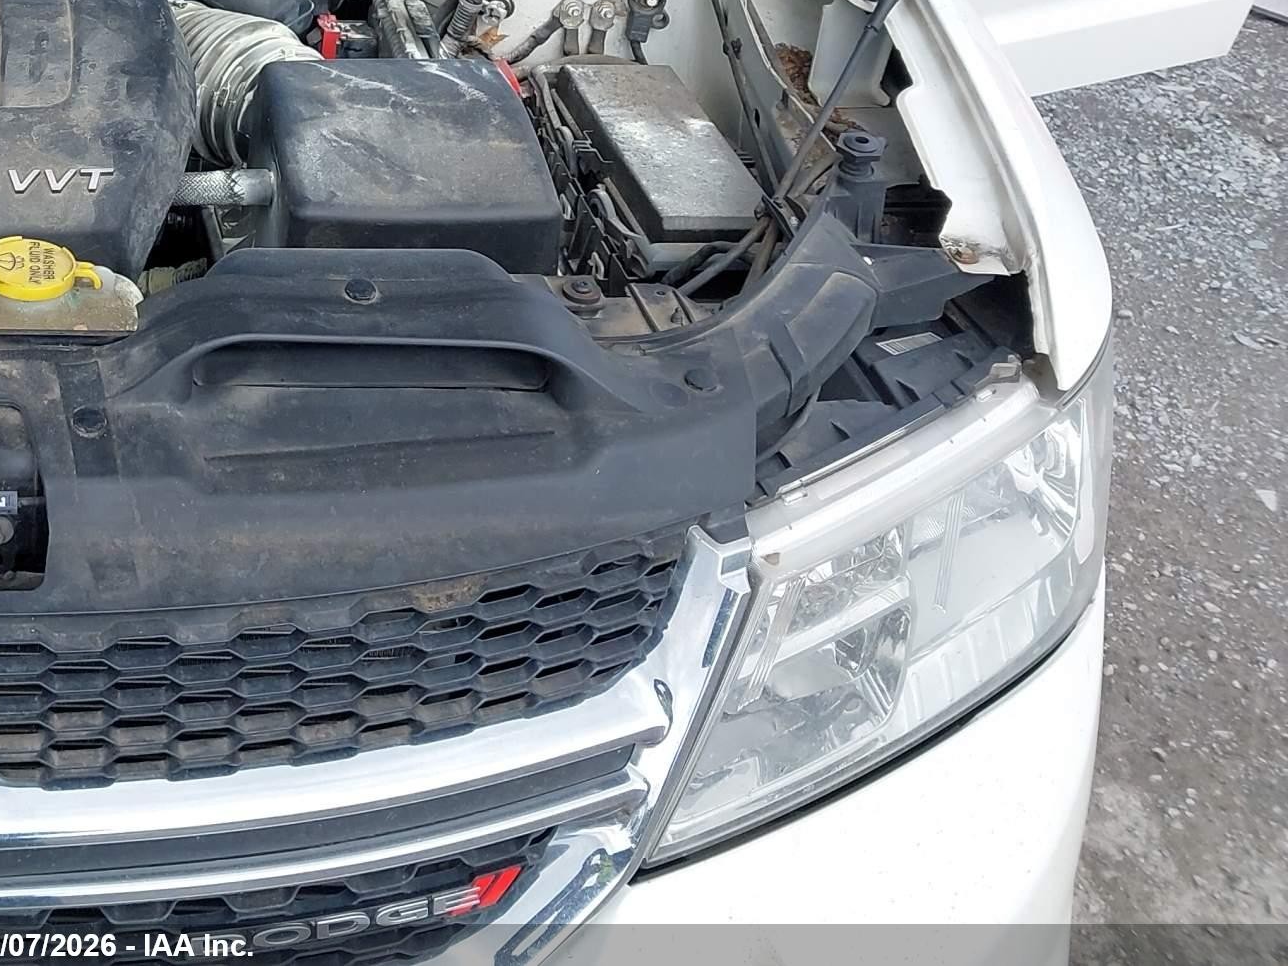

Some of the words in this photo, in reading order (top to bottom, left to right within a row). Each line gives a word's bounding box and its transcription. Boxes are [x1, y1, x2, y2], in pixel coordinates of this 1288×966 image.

[8, 167, 115, 194] VVT
[28, 241, 41, 263] FLUID
[42, 247, 56, 280] WASHER
[28, 264, 42, 285] ONLY
